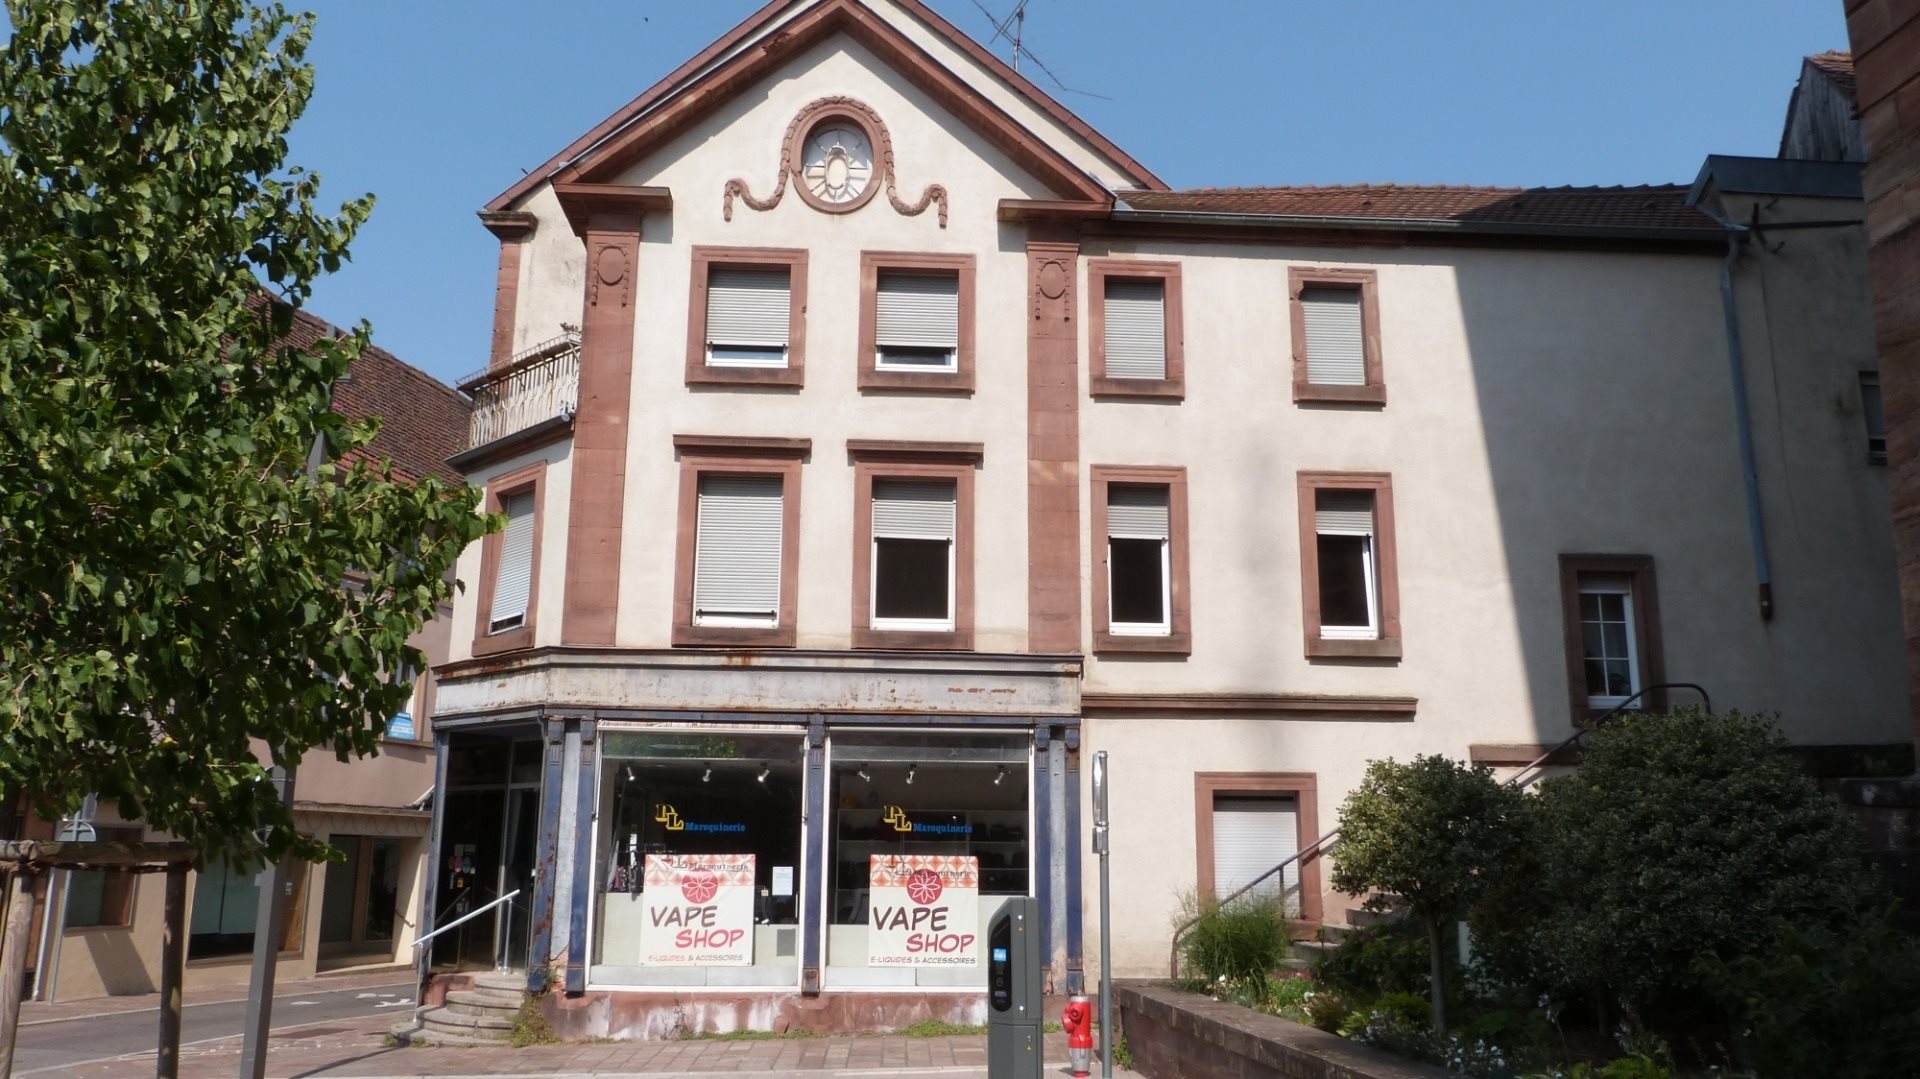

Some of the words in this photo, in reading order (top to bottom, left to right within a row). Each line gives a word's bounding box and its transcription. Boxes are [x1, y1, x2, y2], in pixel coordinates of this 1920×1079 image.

[685, 822, 746, 832] Maroquinerie
[913, 823, 973, 834] Maroquinerie
[651, 905, 718, 927] VAPE
[872, 906, 949, 932] VAPE
[675, 928, 745, 949] SHOP
[906, 933, 975, 953] SHOP
[870, 956, 912, 964] E-LIQUIDES
[922, 957, 976, 965] ACCESSOIRES
